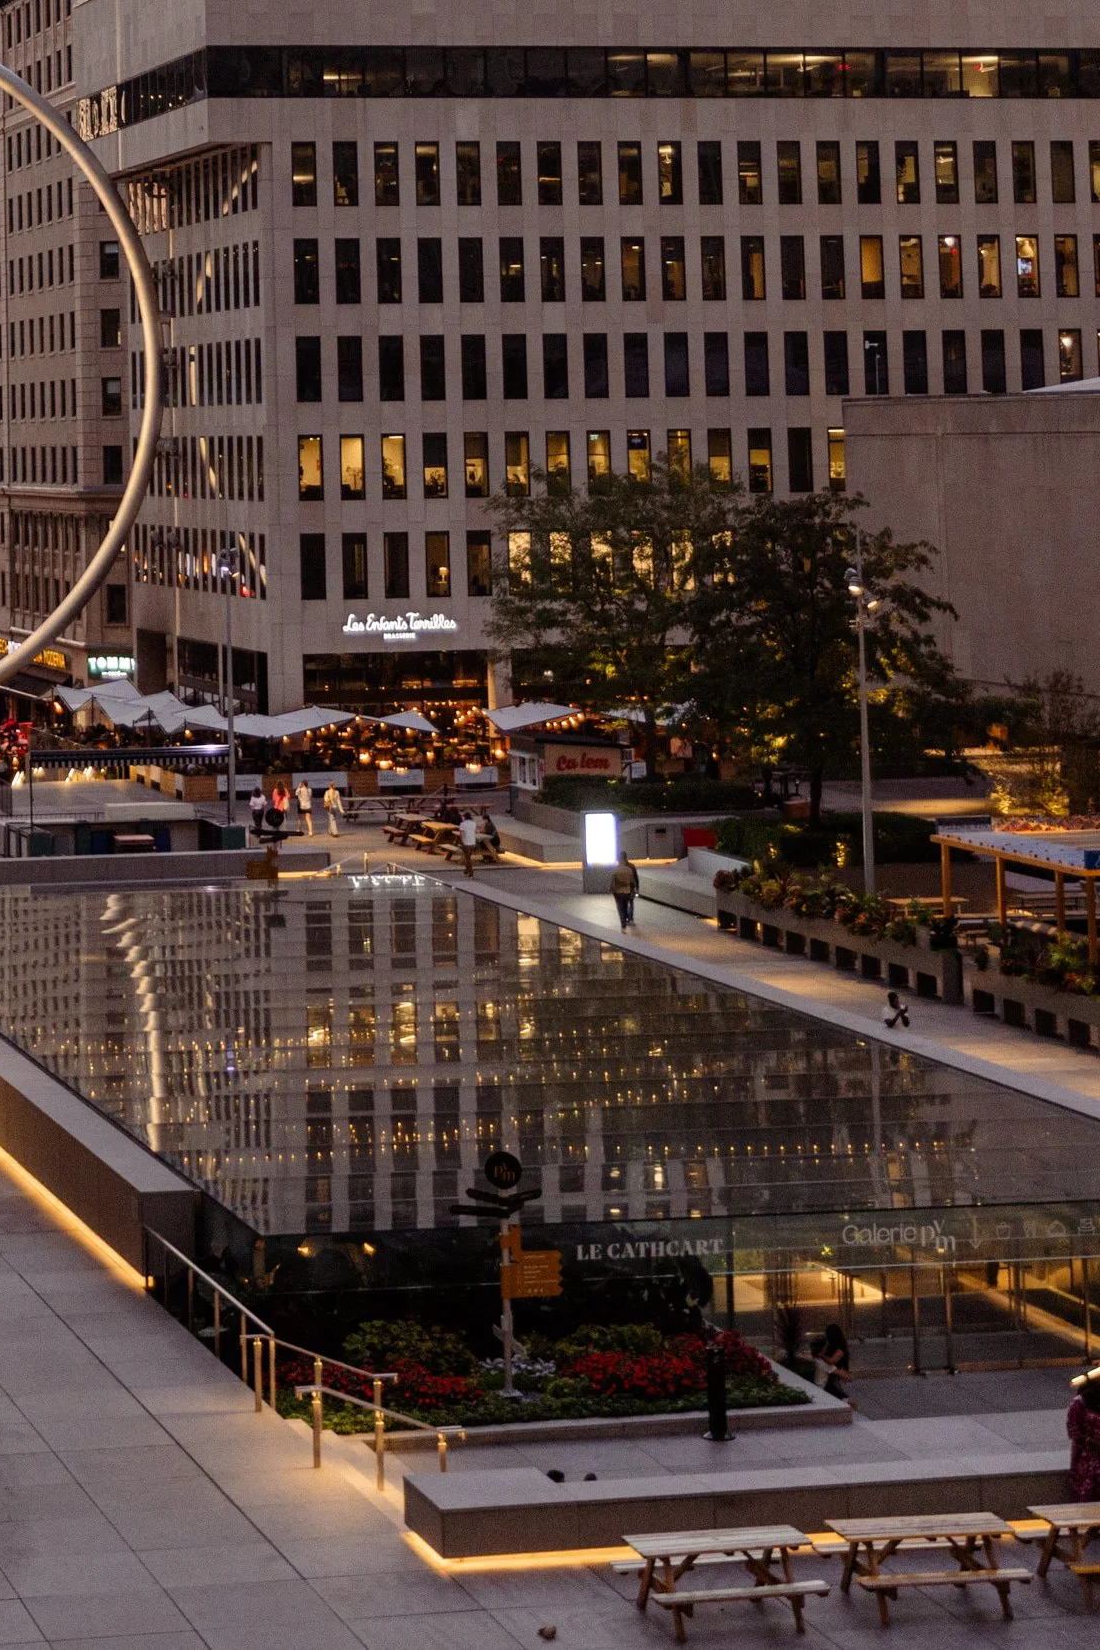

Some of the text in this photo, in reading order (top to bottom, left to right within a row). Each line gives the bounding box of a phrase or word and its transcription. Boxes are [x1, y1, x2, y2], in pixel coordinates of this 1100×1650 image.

[342, 613, 365, 631] Les
[366, 613, 408, 630] Enfants
[842, 1223, 917, 1245] Galerie
[576, 1238, 723, 1261] LE CATHCART
